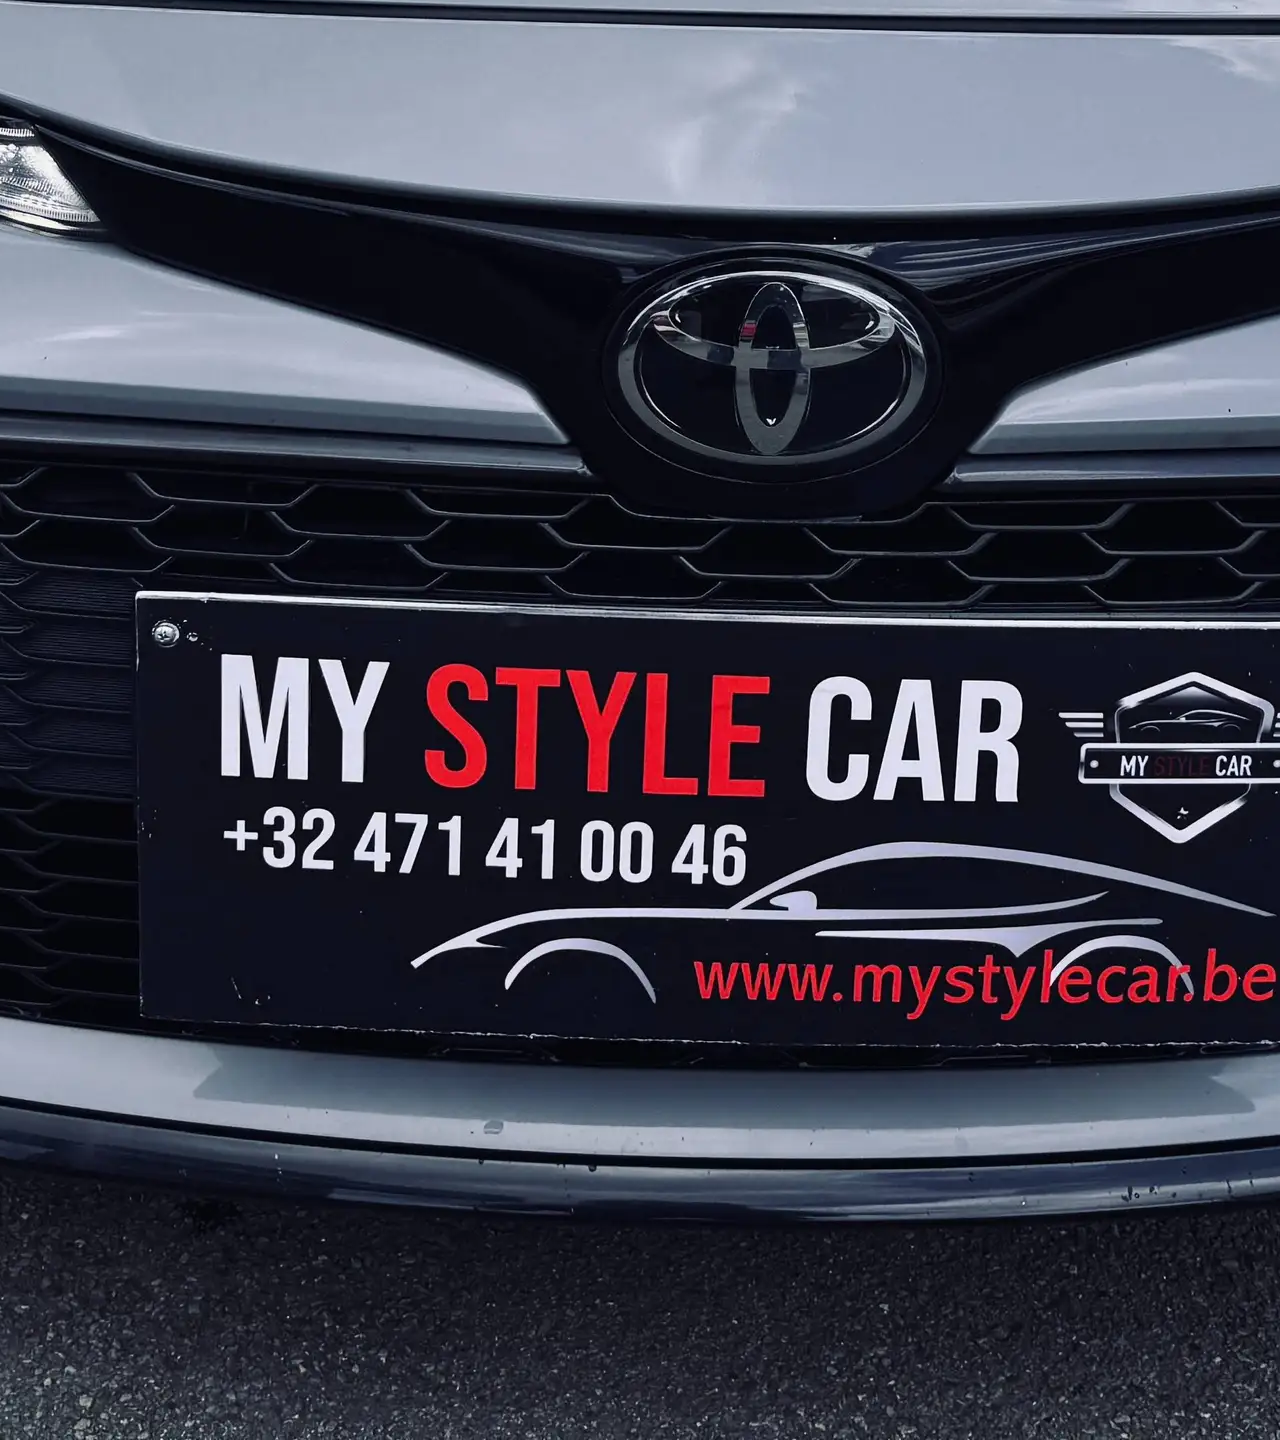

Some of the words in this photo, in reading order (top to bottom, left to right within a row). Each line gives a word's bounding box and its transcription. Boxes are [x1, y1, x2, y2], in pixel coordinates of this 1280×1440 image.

[221, 653, 390, 782] MY
[424, 663, 770, 797] STYLE
[806, 675, 1023, 802] CAR
[1120, 755, 1149, 777] MY
[1153, 756, 1211, 777] STYLE
[1215, 755, 1253, 777] CAR
[223, 806, 336, 870] +32
[354, 811, 461, 876] 471
[485, 817, 555, 879] 41
[579, 820, 654, 883] 00
[671, 824, 748, 886] 46
[693, 948, 1277, 1020] www.mystylecar.be
